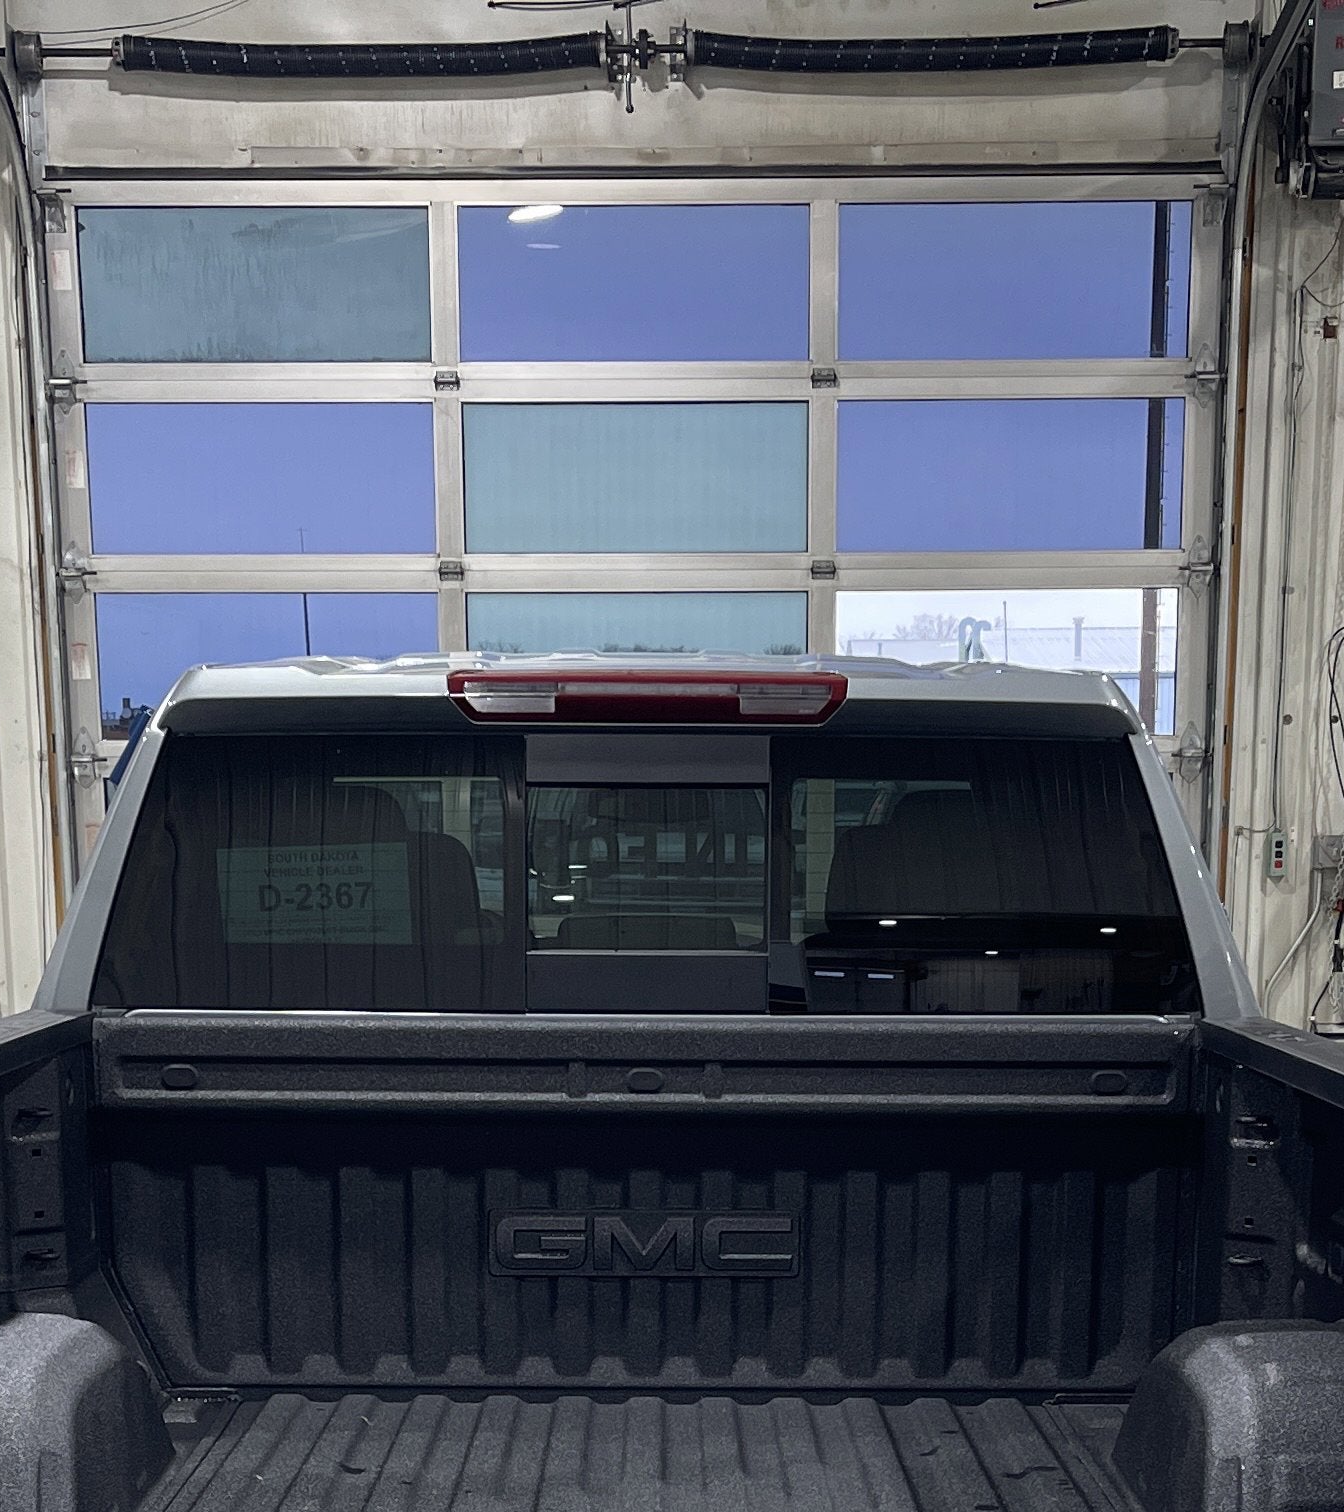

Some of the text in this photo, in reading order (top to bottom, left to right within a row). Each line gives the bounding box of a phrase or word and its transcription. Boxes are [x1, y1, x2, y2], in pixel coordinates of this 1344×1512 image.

[267, 850, 359, 864] SOUTH DAKOTA
[263, 865, 364, 878] VEHICLE DEALER
[258, 881, 374, 912] D-2367
[496, 1216, 794, 1271] GMC
